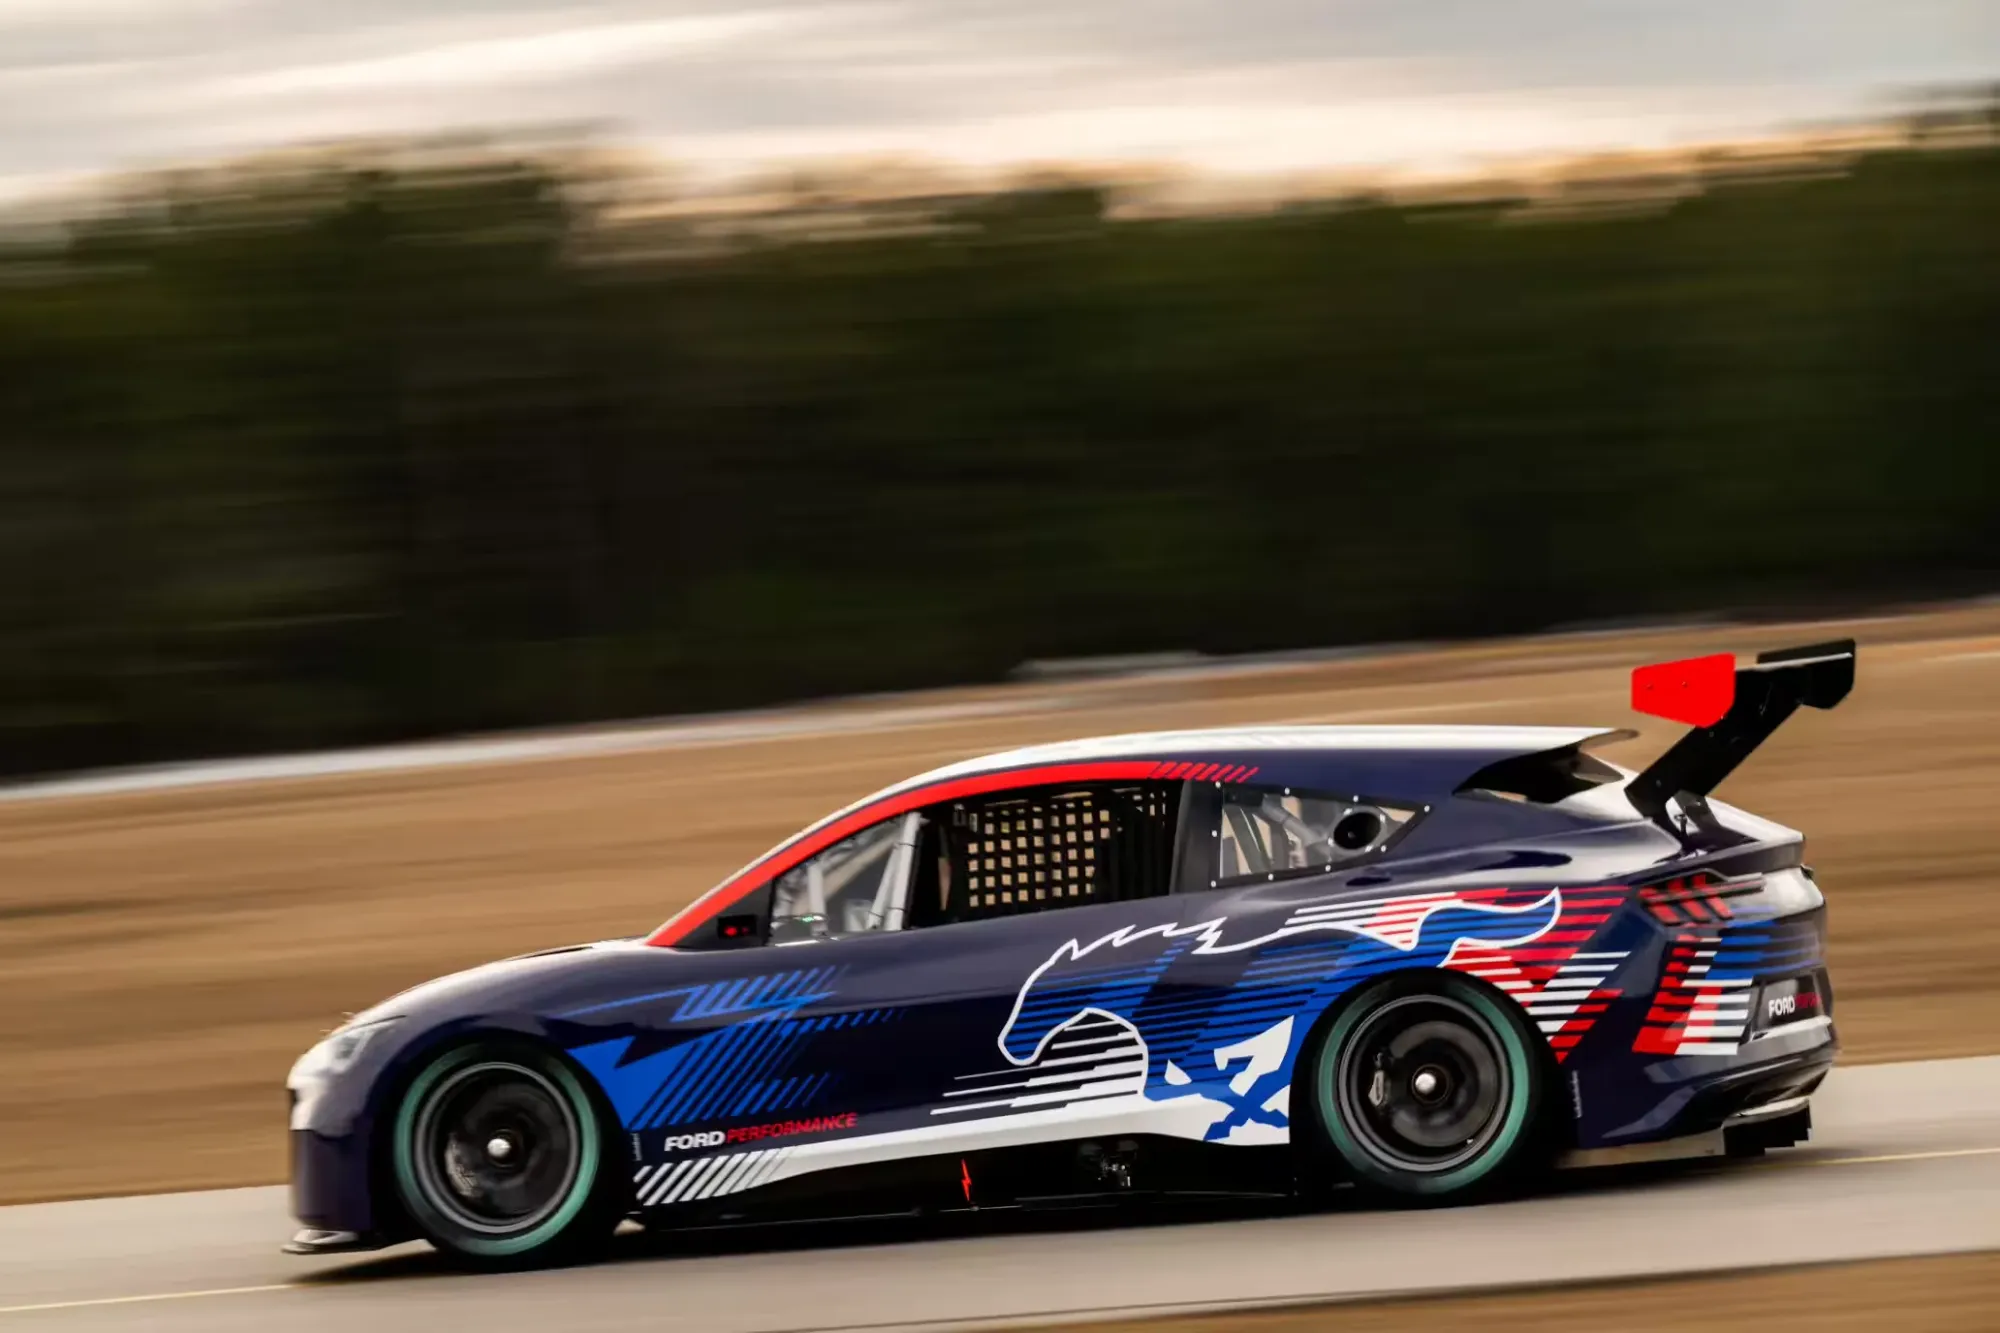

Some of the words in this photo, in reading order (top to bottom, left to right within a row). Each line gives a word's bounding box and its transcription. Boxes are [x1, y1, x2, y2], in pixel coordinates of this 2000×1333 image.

[1768, 995, 1796, 1018] FORD
[664, 1130, 726, 1151] FORD
[726, 1112, 858, 1143] PERFORMANCE
